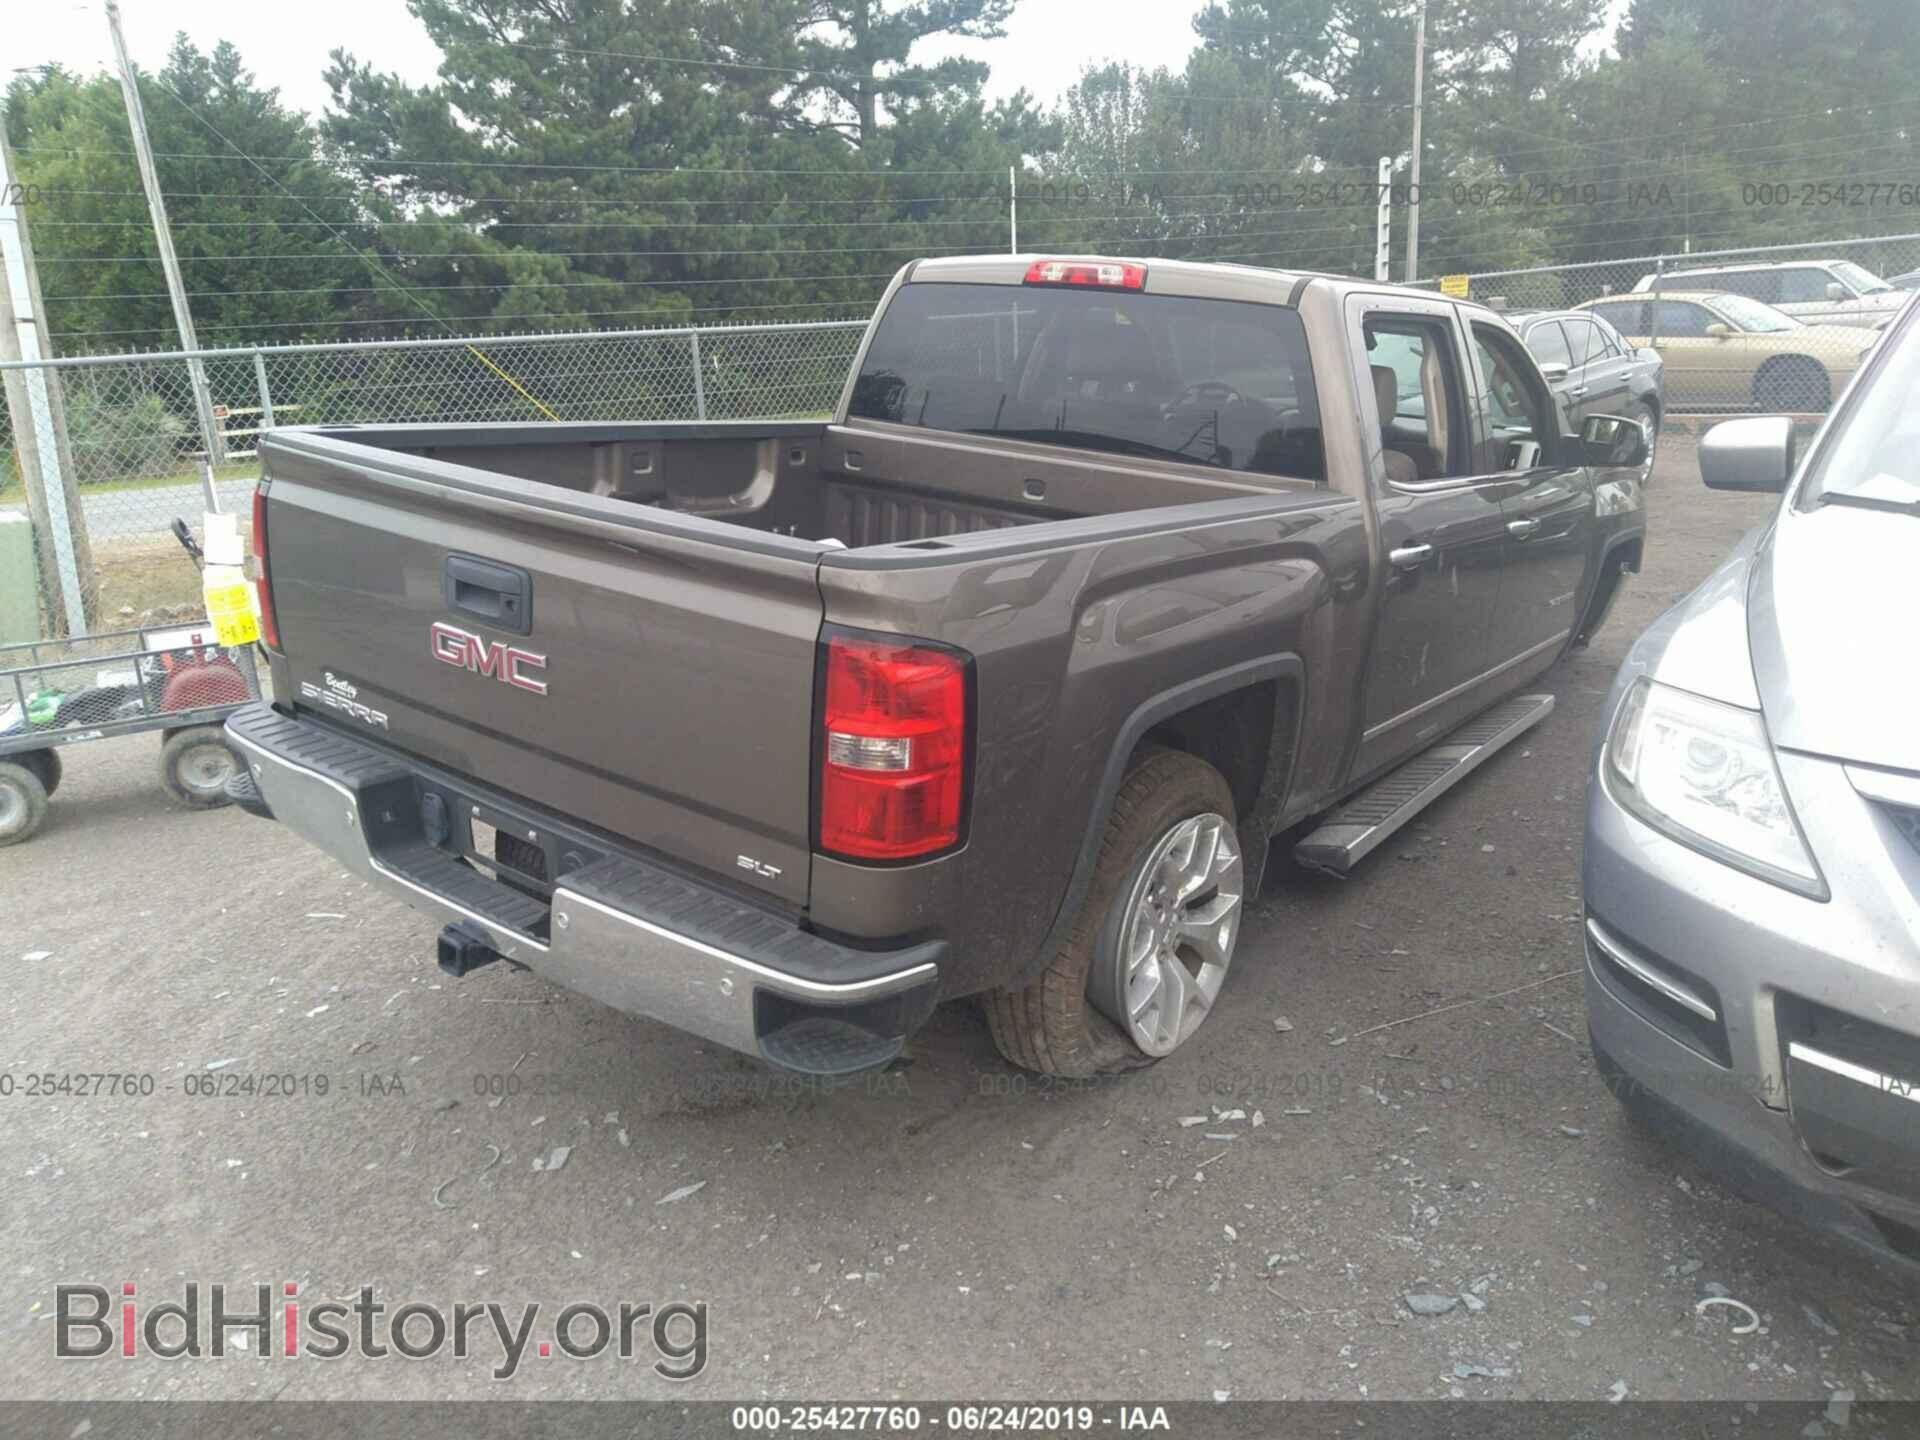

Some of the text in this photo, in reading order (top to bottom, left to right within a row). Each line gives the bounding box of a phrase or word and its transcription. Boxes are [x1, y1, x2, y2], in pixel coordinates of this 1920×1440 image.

[431, 622, 548, 695] GMC
[301, 681, 389, 730] SIERRA
[736, 854, 782, 879] SLT
